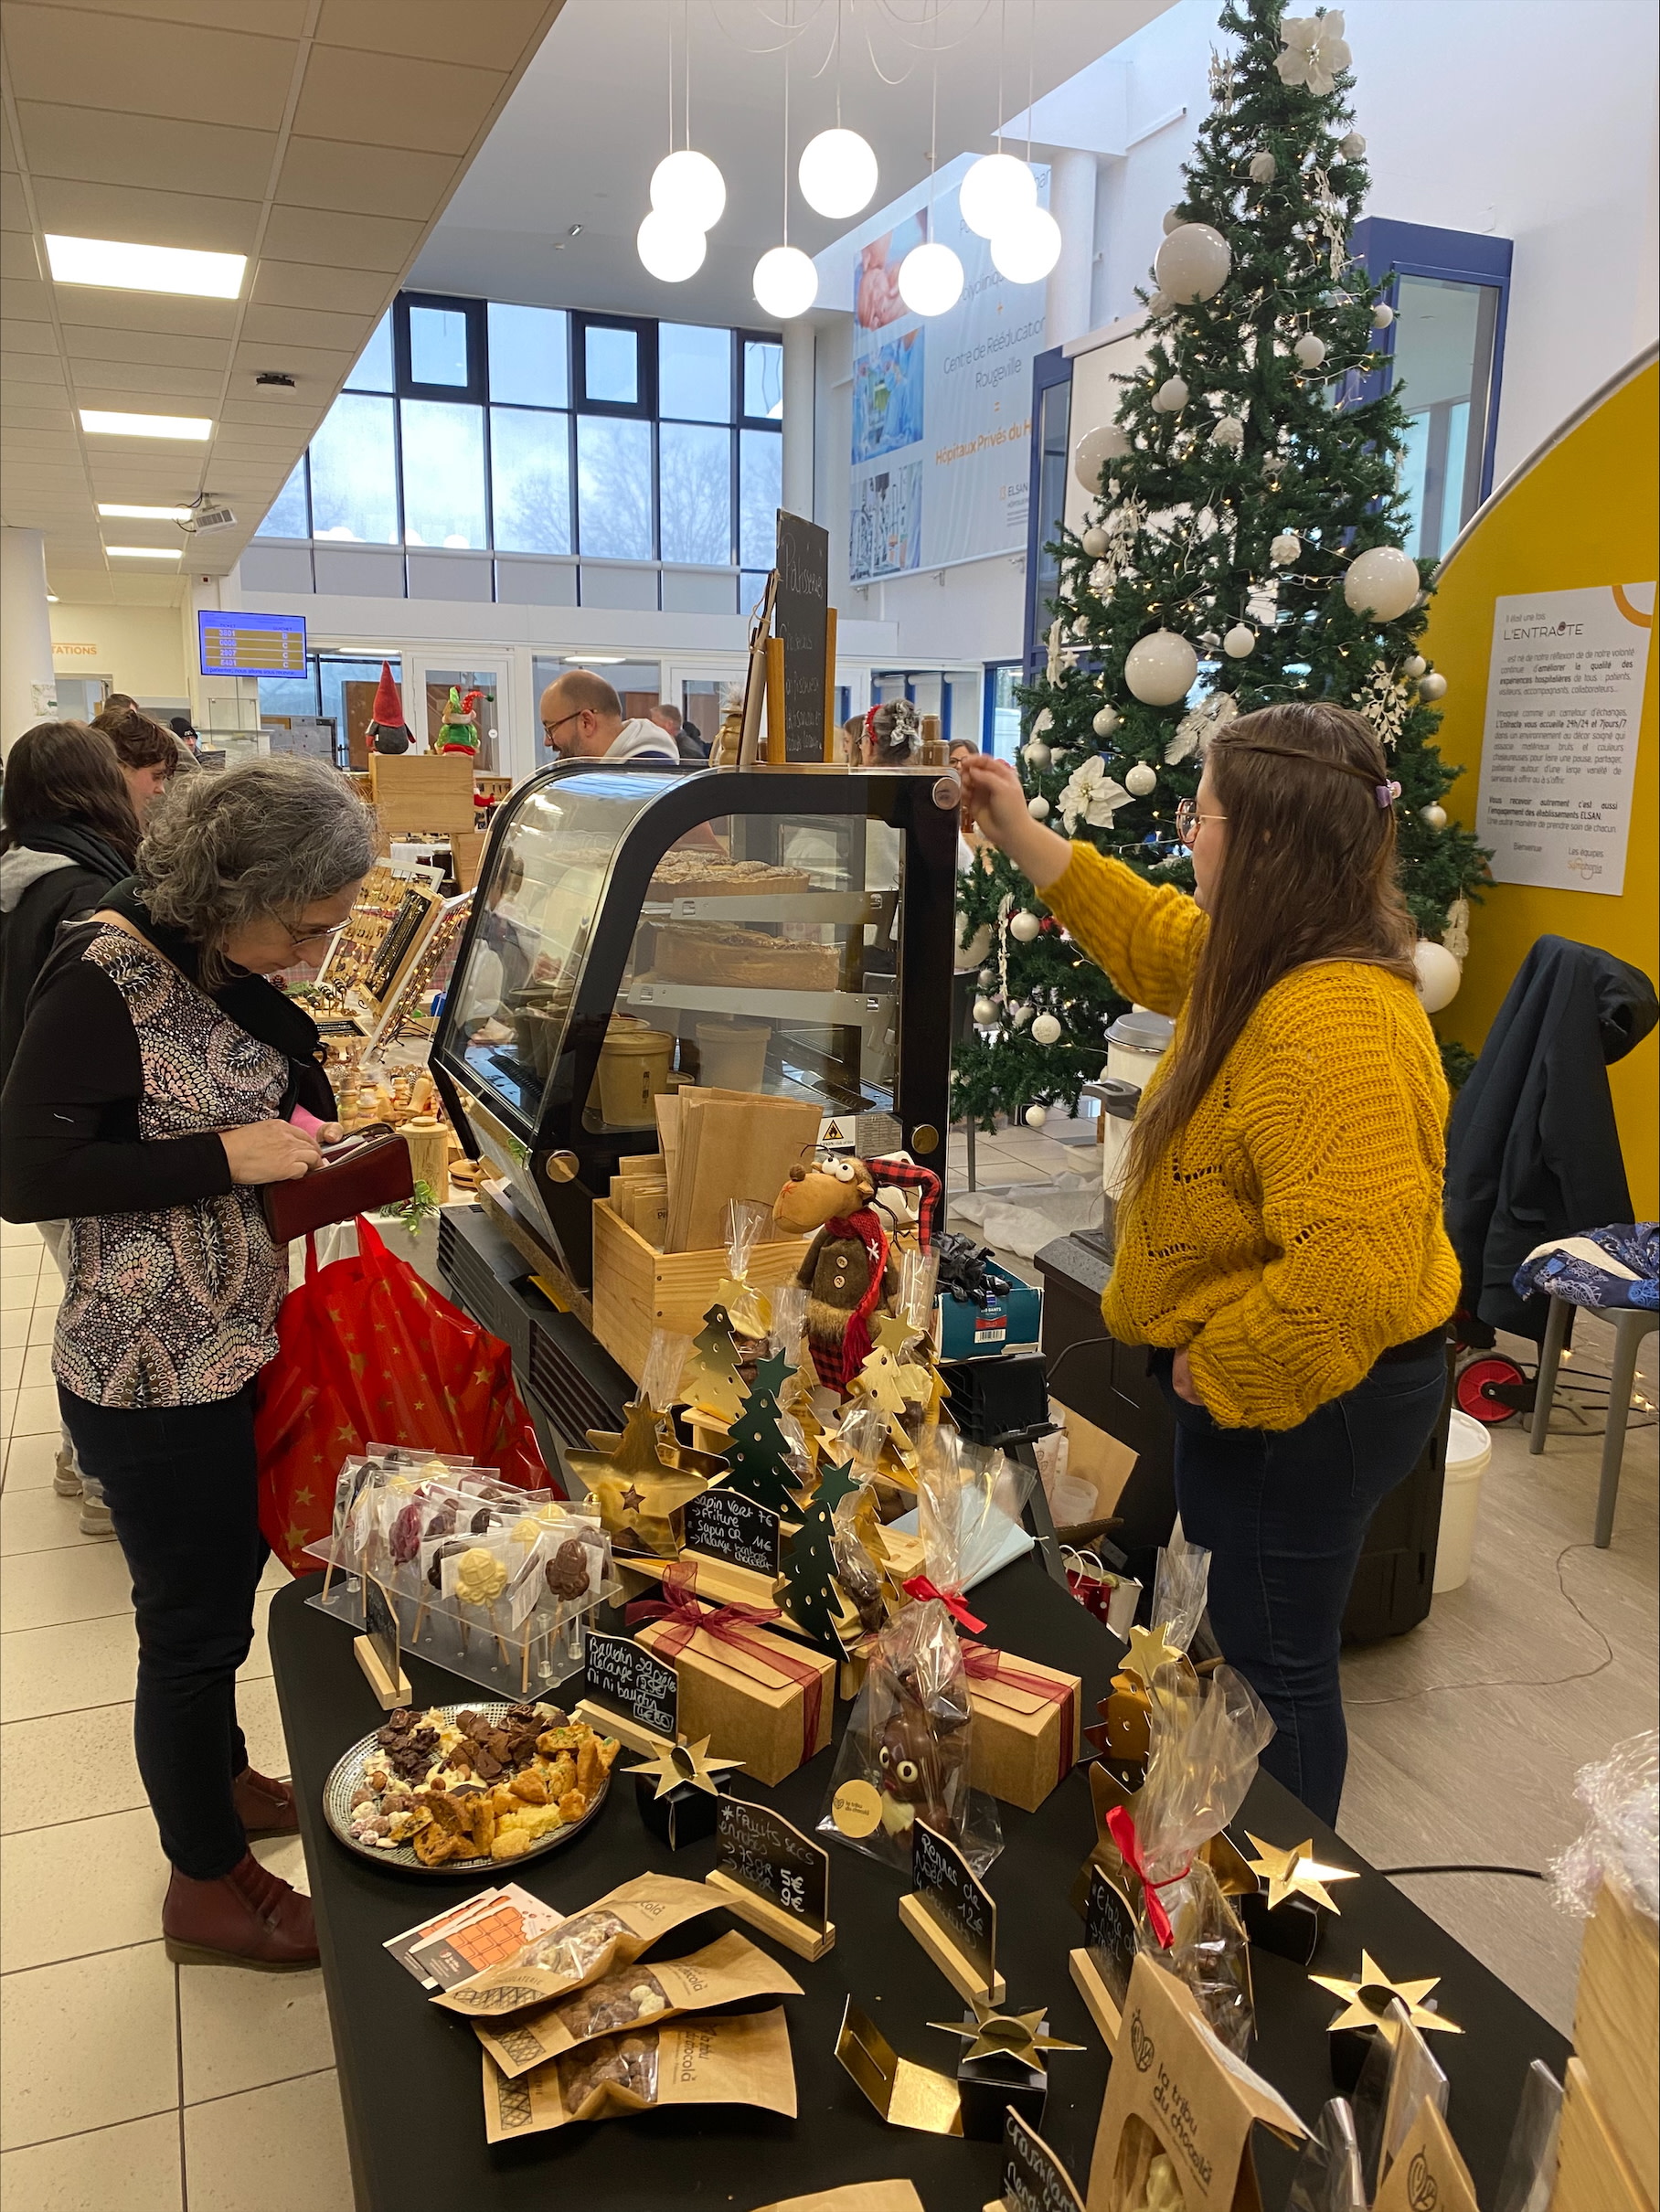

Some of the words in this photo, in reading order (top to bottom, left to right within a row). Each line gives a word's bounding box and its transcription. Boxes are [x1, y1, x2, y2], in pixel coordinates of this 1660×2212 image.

[943, 350, 972, 375] Centre
[974, 343, 986, 361] de
[975, 356, 1022, 389] Rougeville
[936, 441, 976, 465] Hôpitaux
[977, 427, 1006, 452] Privés
[1008, 421, 1022, 441] du
[1504, 622, 1584, 640] L'ENTRACTE
[51, 645, 97, 655] TATIONS
[1591, 660, 1612, 672] qualité
[1622, 659, 1633, 668] des
[1578, 800, 1592, 808] c'est
[1601, 802, 1618, 810] aussi
[1514, 842, 1543, 853] Bienvenue
[1568, 847, 1579, 856] Les
[1580, 848, 1604, 858] équipes
[694, 1495, 722, 1510] Sapin
[759, 1510, 772, 1527] 7€
[697, 1519, 724, 1537] Sapin
[736, 1806, 781, 1846] Fruits
[785, 1838, 814, 1866] secs
[781, 1868, 805, 1895] 5€
[781, 1887, 805, 1913] 9€
[963, 1884, 981, 1911] de
[1153, 2085, 1170, 2115] du
[1158, 2062, 1170, 2090] la
[1171, 2083, 1197, 2136] tribu
